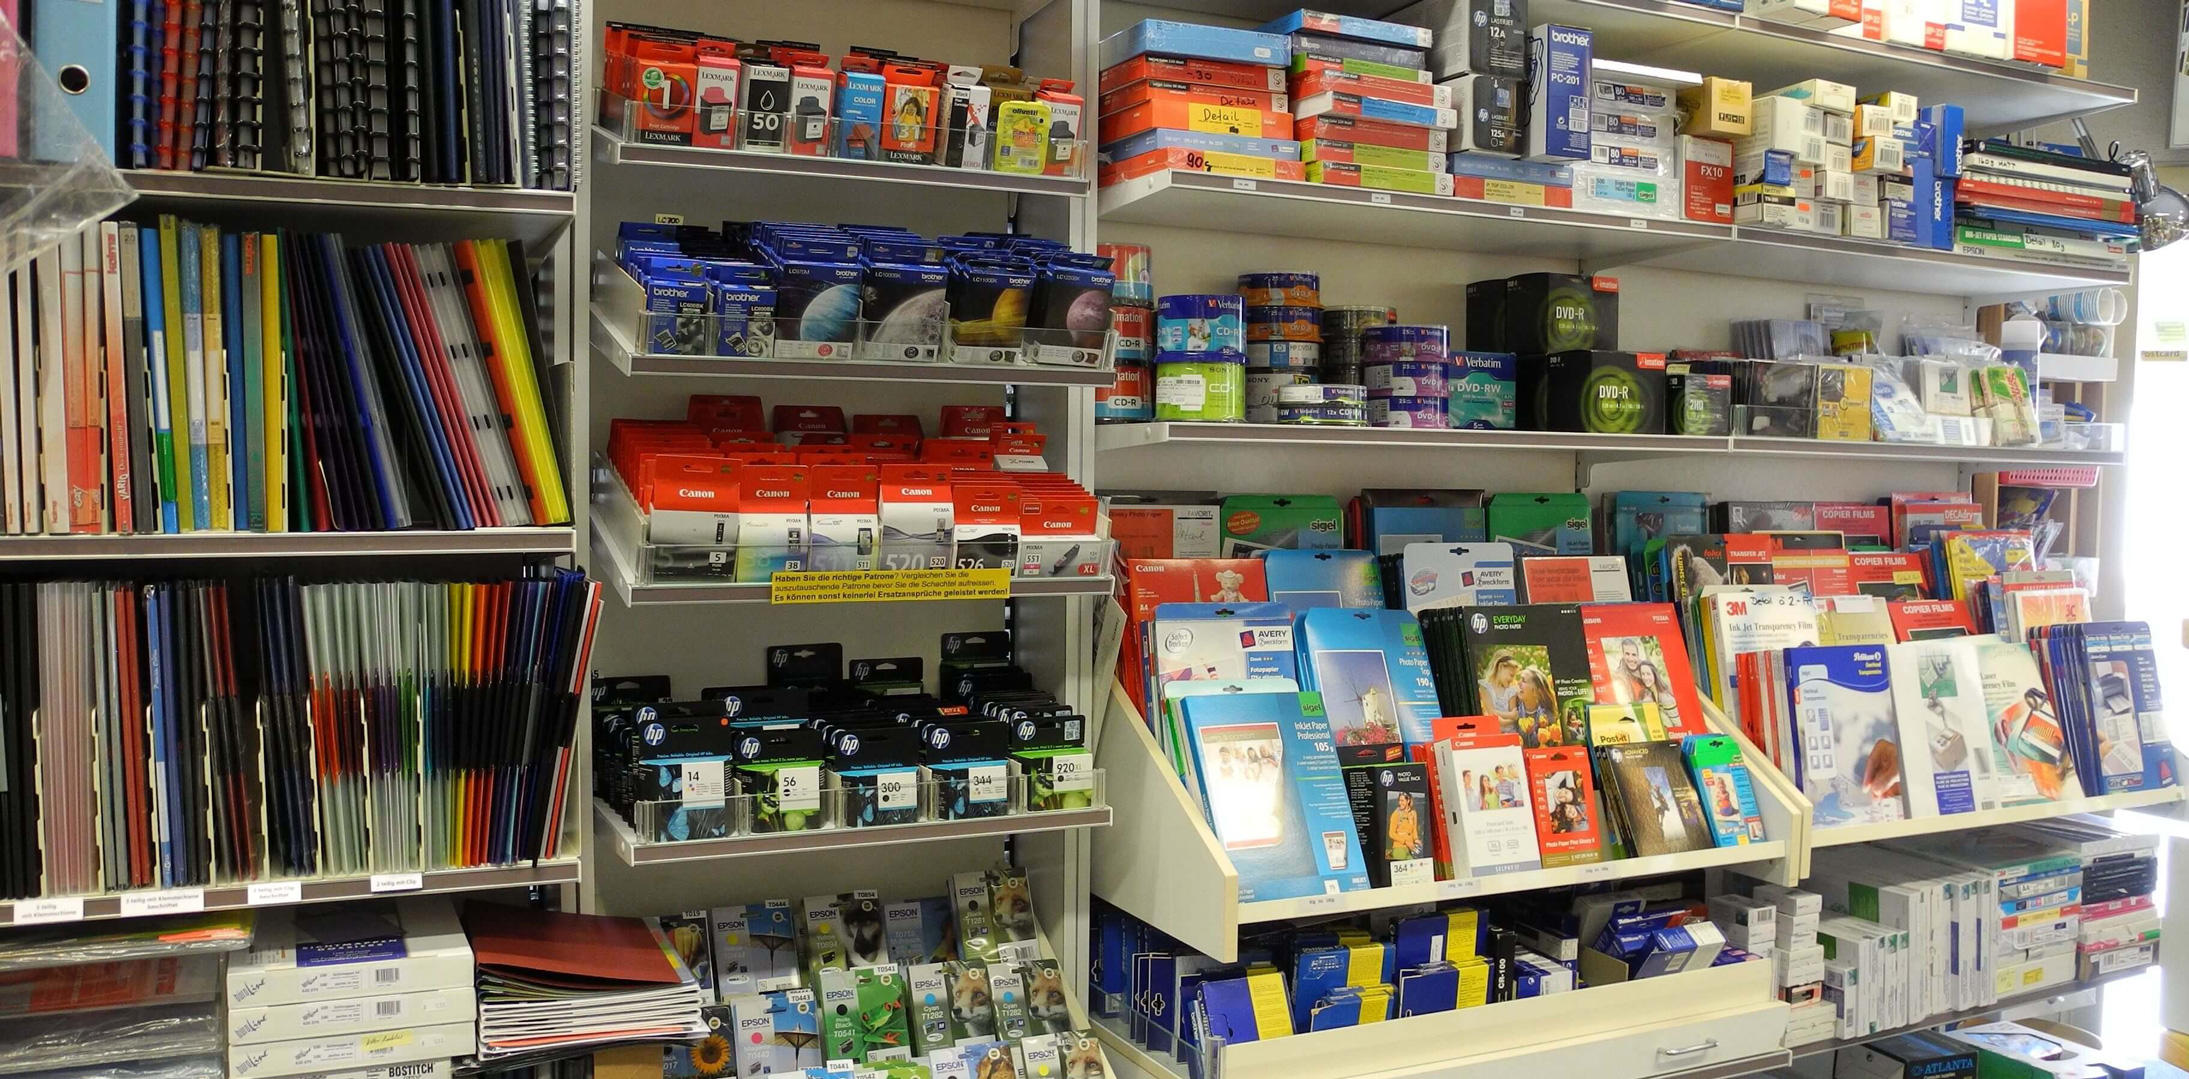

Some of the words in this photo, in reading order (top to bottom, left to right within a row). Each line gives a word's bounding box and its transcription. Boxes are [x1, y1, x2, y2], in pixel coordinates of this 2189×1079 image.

[1473, 11, 1487, 26] hp
[1490, 27, 1506, 38] 12A
[1552, 30, 1590, 46] brother
[702, 71, 735, 82] LEXMARK
[753, 68, 787, 78] LEXMARK
[1551, 73, 1580, 85] PC-201
[797, 81, 828, 92] LEXMARK
[848, 80, 883, 93] LEXMARK
[1614, 87, 1625, 96] 80
[853, 96, 876, 105] COLOR
[1051, 107, 1078, 116] LEXMARK
[1204, 108, 1239, 121] Detail
[1478, 109, 1489, 122] hp
[752, 114, 779, 131] 50
[1608, 117, 1618, 126] 80
[645, 131, 681, 142] LEXMARK
[1491, 129, 1505, 138] 125A
[890, 152, 922, 161] LEXMARK
[1610, 149, 1620, 158] 80
[1955, 134, 1964, 174] brother
[1701, 166, 1723, 178] FX10
[1934, 181, 1943, 221] brother
[1963, 246, 1984, 255] EPSON
[921, 273, 944, 281] brother
[1009, 277, 1032, 286] brother
[1091, 276, 1113, 284] brother
[654, 287, 688, 298] brother
[726, 293, 760, 302] brother
[1556, 307, 1584, 319] DVD-R
[1119, 340, 1140, 348] CD-R
[1466, 356, 1501, 368] Verbatim
[1458, 384, 1501, 393] DVD-RW
[1600, 386, 1628, 398] DVD-R
[1114, 398, 1137, 406] CD-R
[117, 473, 129, 500] VARIO
[679, 489, 715, 498] Canon
[756, 489, 790, 498] Canon
[827, 489, 860, 498] Canon
[901, 488, 932, 496] Canon
[971, 504, 1000, 512] Canon
[1823, 510, 1849, 519] COPIER
[1851, 510, 1875, 519] FILMS
[1043, 520, 1072, 529] Canon
[1310, 519, 1336, 531] sigel
[1567, 519, 1588, 530] sigel
[715, 554, 721, 562] 5
[885, 553, 925, 570] 520
[931, 557, 945, 566] 520
[1026, 554, 1040, 563] 551
[1854, 557, 1883, 566] COPIER
[1884, 557, 1906, 566] FILMS
[787, 562, 798, 570] 38
[857, 561, 869, 569] 511
[957, 558, 984, 570] 526
[1003, 560, 1014, 568] 526
[1083, 564, 1095, 573] XL
[1136, 564, 1164, 572] Canon
[832, 574, 862, 582] richtige
[864, 571, 898, 581] Patrone?
[901, 571, 943, 580] Vergleichen
[775, 583, 839, 591] auszutauschende
[842, 591, 876, 599] keinerlei
[878, 590, 941, 599] Ersatzansprüche
[944, 589, 976, 597] geleistet
[1726, 601, 1748, 616] 3M
[1903, 605, 1932, 614] COPIER
[1932, 604, 1955, 613] FILMS
[1472, 614, 1487, 633] hp
[1493, 615, 1526, 623] EVERYDAY
[1729, 623, 1741, 631] Ink
[1743, 623, 1753, 632] Jet
[1754, 622, 1796, 633] Transparency
[1798, 621, 1813, 630] Film
[1399, 658, 1413, 666] Photo
[1413, 658, 1427, 667] Paper
[1416, 678, 1428, 686] 190
[725, 698, 742, 715] hp
[1018, 722, 1036, 738] hp
[1312, 721, 1328, 731] Paper
[645, 727, 663, 744] hp
[931, 730, 950, 746] hp
[1297, 731, 1330, 740] Professional
[1600, 734, 1627, 743] Post-it
[742, 740, 760, 757] hp
[840, 735, 859, 754] hp
[1314, 742, 1329, 751] 105
[687, 771, 700, 781] 14
[1380, 770, 1394, 786] hp
[783, 777, 796, 786] 56
[973, 776, 992, 786] 344
[881, 782, 900, 793] 300
[1394, 865, 1408, 873] 364
[959, 887, 985, 896] EPSON
[810, 910, 836, 918] EPSON
[889, 909, 918, 918] EPSON
[718, 921, 745, 930] EPSON
[915, 979, 942, 989] EPSON
[993, 978, 1020, 987] EPSON
[826, 991, 854, 1000] EPSON
[924, 1005, 940, 1013] Cyan
[921, 1012, 943, 1020] T1282
[741, 1018, 770, 1027] EPSON
[834, 1030, 855, 1038] T0541
[1028, 1050, 1056, 1060] EPSON
[936, 1061, 964, 1070] EPSON
[1924, 1058, 1974, 1074] ATLANTA
[389, 1063, 435, 1078] BOSTITCH
